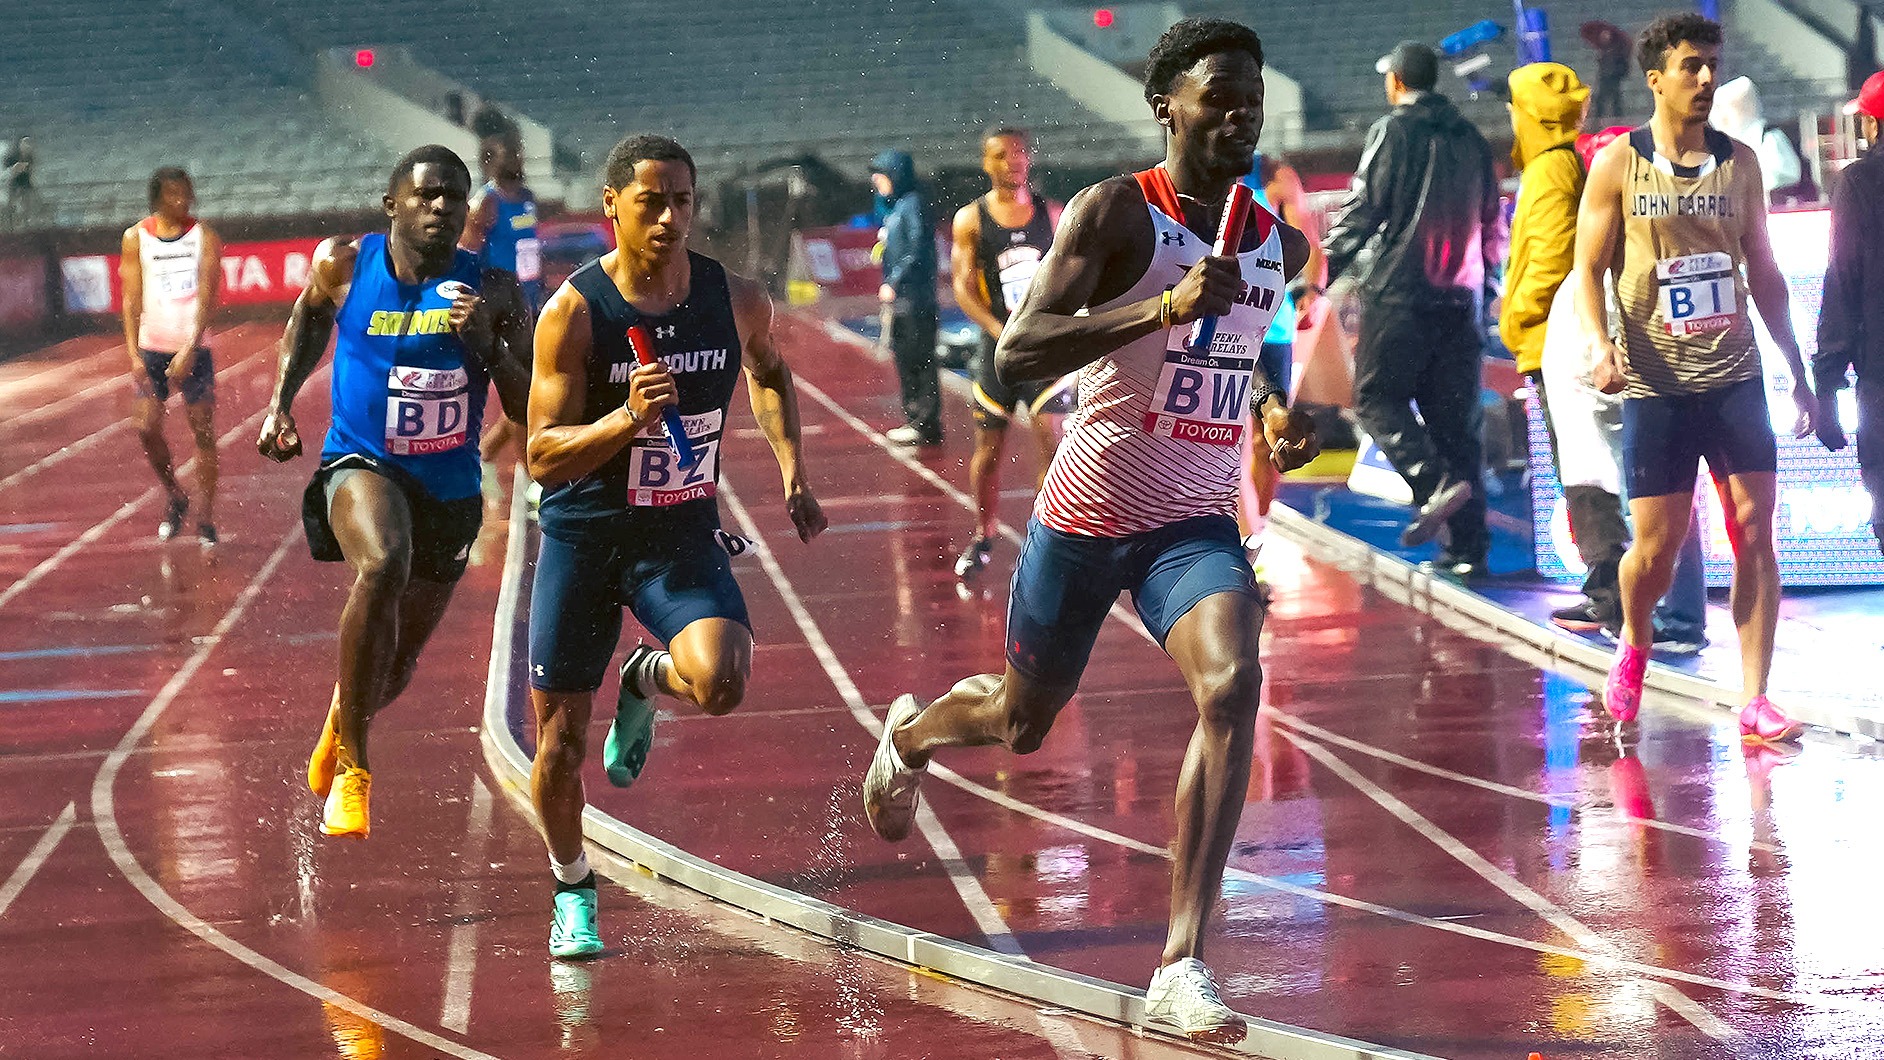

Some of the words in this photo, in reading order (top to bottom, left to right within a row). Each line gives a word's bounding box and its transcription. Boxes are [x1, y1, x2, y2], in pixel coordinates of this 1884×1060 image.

[1632, 195, 1669, 216] JOHN
[1678, 195, 1735, 217] CARROL
[1255, 258, 1282, 273] MEAC
[1233, 279, 1276, 312] GAN
[1213, 332, 1242, 343] PENN
[1209, 343, 1248, 355] RELAYS
[608, 348, 727, 383] MOUTH
[1181, 354, 1207, 366] Dream
[1163, 367, 1250, 420] BW
[682, 417, 706, 428] ENN
[1179, 422, 1233, 441] TOYOTA
[411, 436, 458, 452] TOYOTA
[656, 487, 707, 504] TOYOTA
